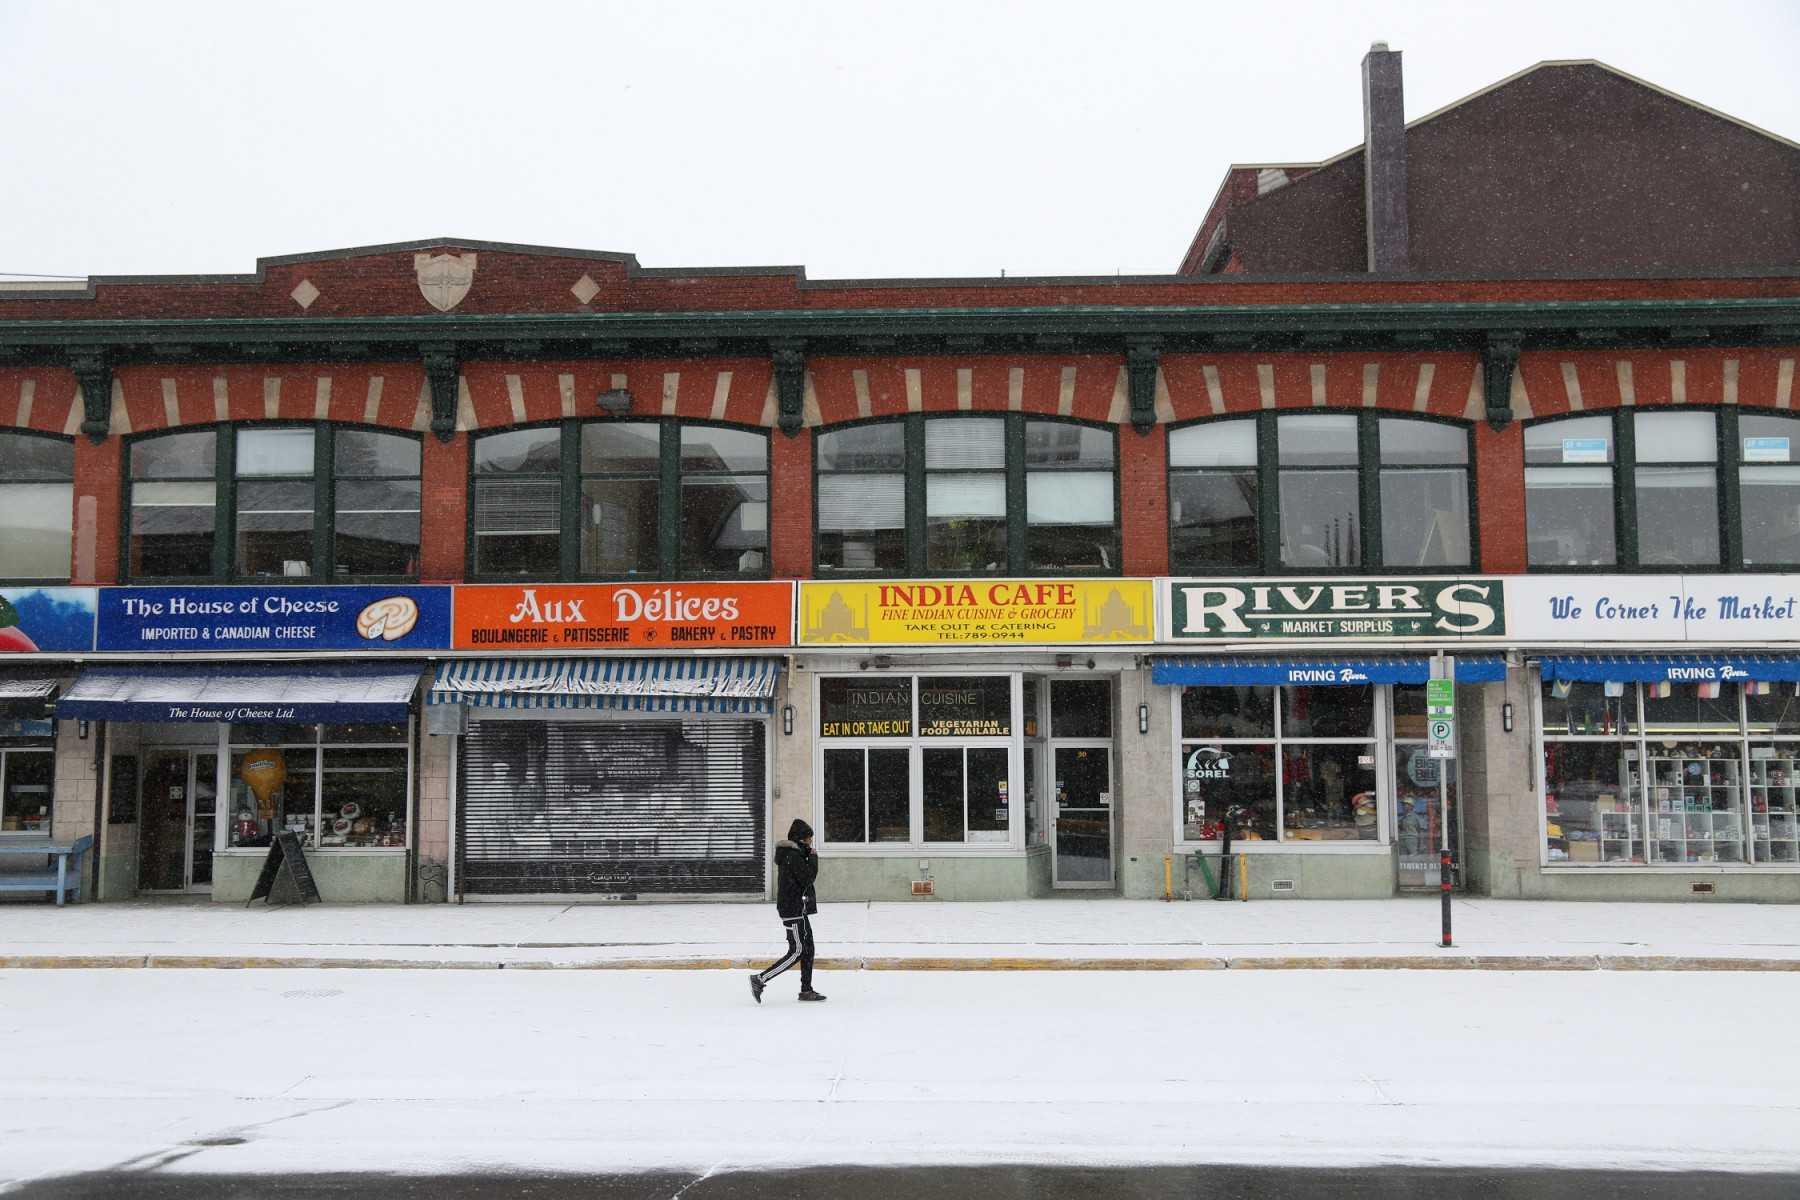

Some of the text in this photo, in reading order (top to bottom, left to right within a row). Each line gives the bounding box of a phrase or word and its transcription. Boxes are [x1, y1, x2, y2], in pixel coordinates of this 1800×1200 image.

[879, 583, 1077, 607] INDIA CAFE
[122, 596, 340, 617] The House of Cheese
[509, 588, 740, 623] Aux Délices
[1181, 583, 1496, 633] RIVERS
[1549, 596, 1798, 620] We Corner The Market
[881, 607, 1076, 620] FINE INDIAN CUISINE & GROCERY
[141, 625, 317, 640] IMPORTED & CANADIAN CHEESE
[671, 627, 716, 641] BAKERY
[731, 625, 777, 640] PASTRY
[940, 623, 970, 631] OUT
[990, 622, 1057, 630] CATERING
[1283, 620, 1394, 633] MARKET SURPLUS
[471, 629, 548, 643] BOULANGERIE
[563, 627, 630, 642] PATISSERIE
[1289, 670, 1336, 682] IRVING
[1667, 667, 1716, 679] IRVING
[852, 691, 977, 705] INDIAN CUISINE
[169, 706, 296, 721] The House of Cheese Ltd.
[823, 720, 910, 736] EAT IN OR TAKE OUT
[921, 727, 1010, 736] FOOD AVAILABLE
[931, 720, 999, 728] VEGETARIAN
[1187, 770, 1230, 778] SOREL
